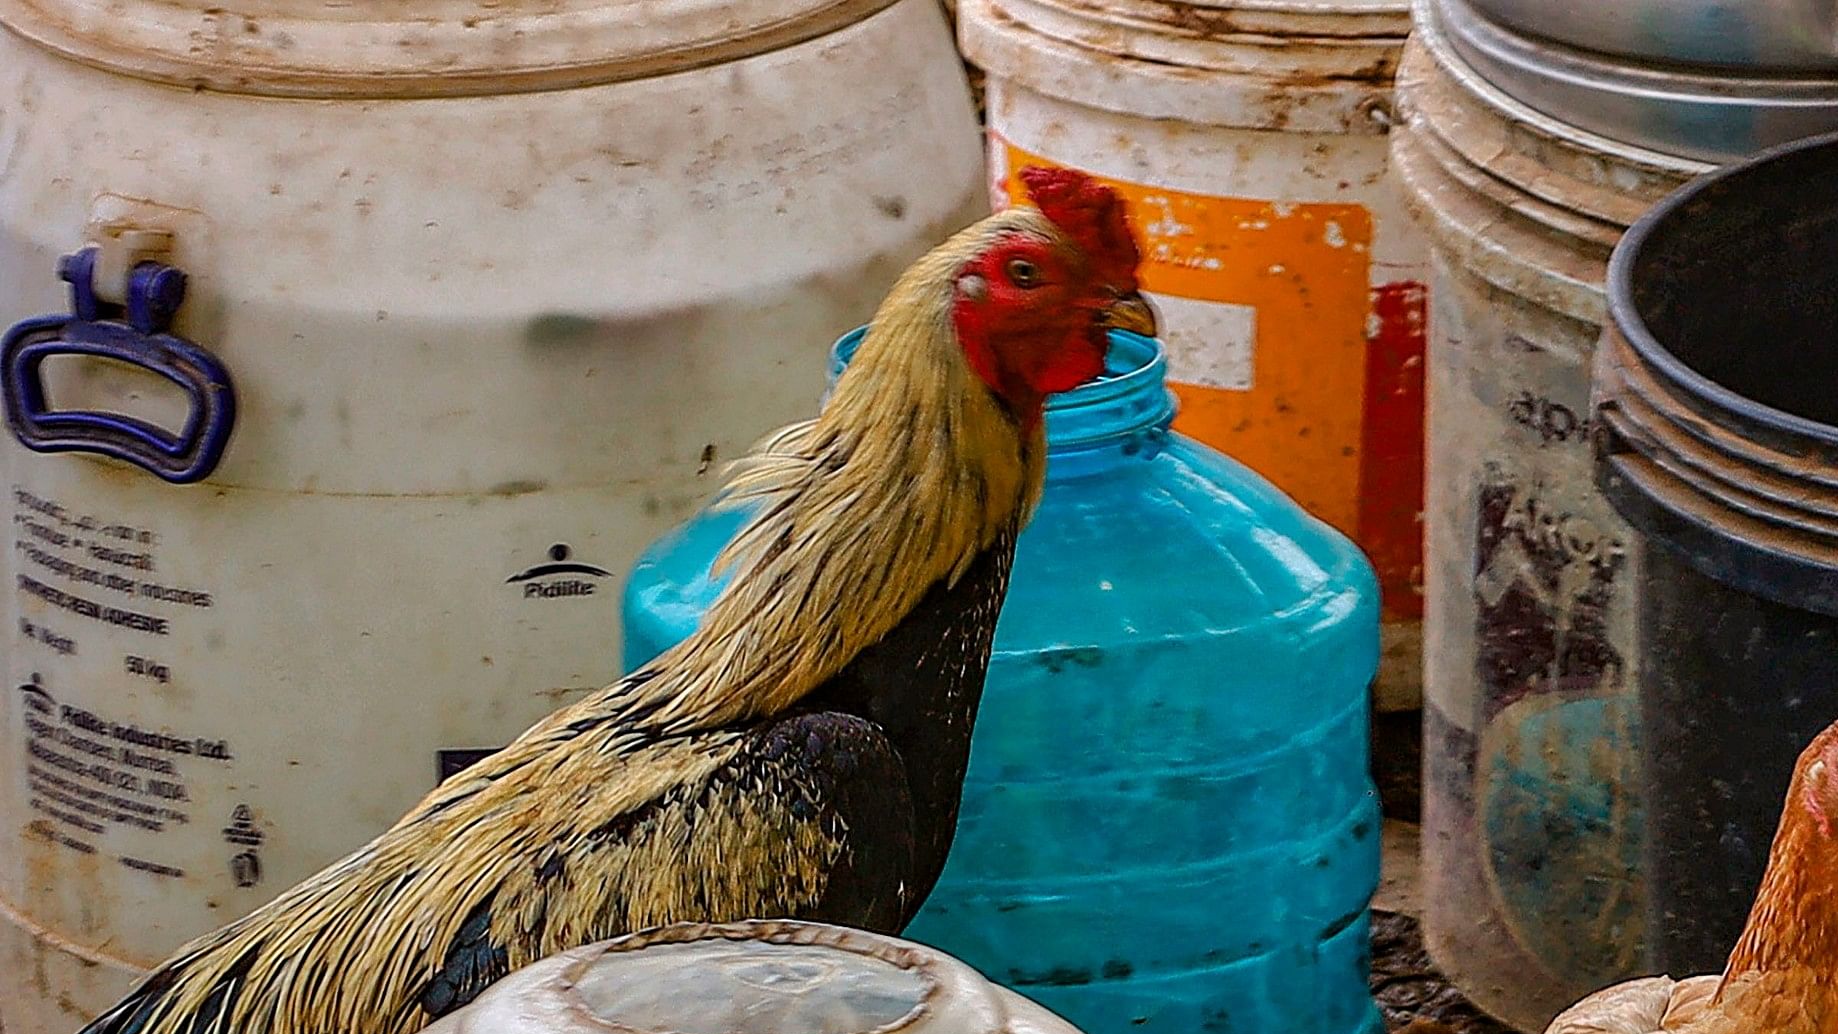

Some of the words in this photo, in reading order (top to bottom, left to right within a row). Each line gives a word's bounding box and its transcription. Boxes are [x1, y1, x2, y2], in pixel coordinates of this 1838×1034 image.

[523, 580, 597, 599] Pidilite
[60, 703, 108, 735] Pidilite
[110, 722, 192, 755] Industries
